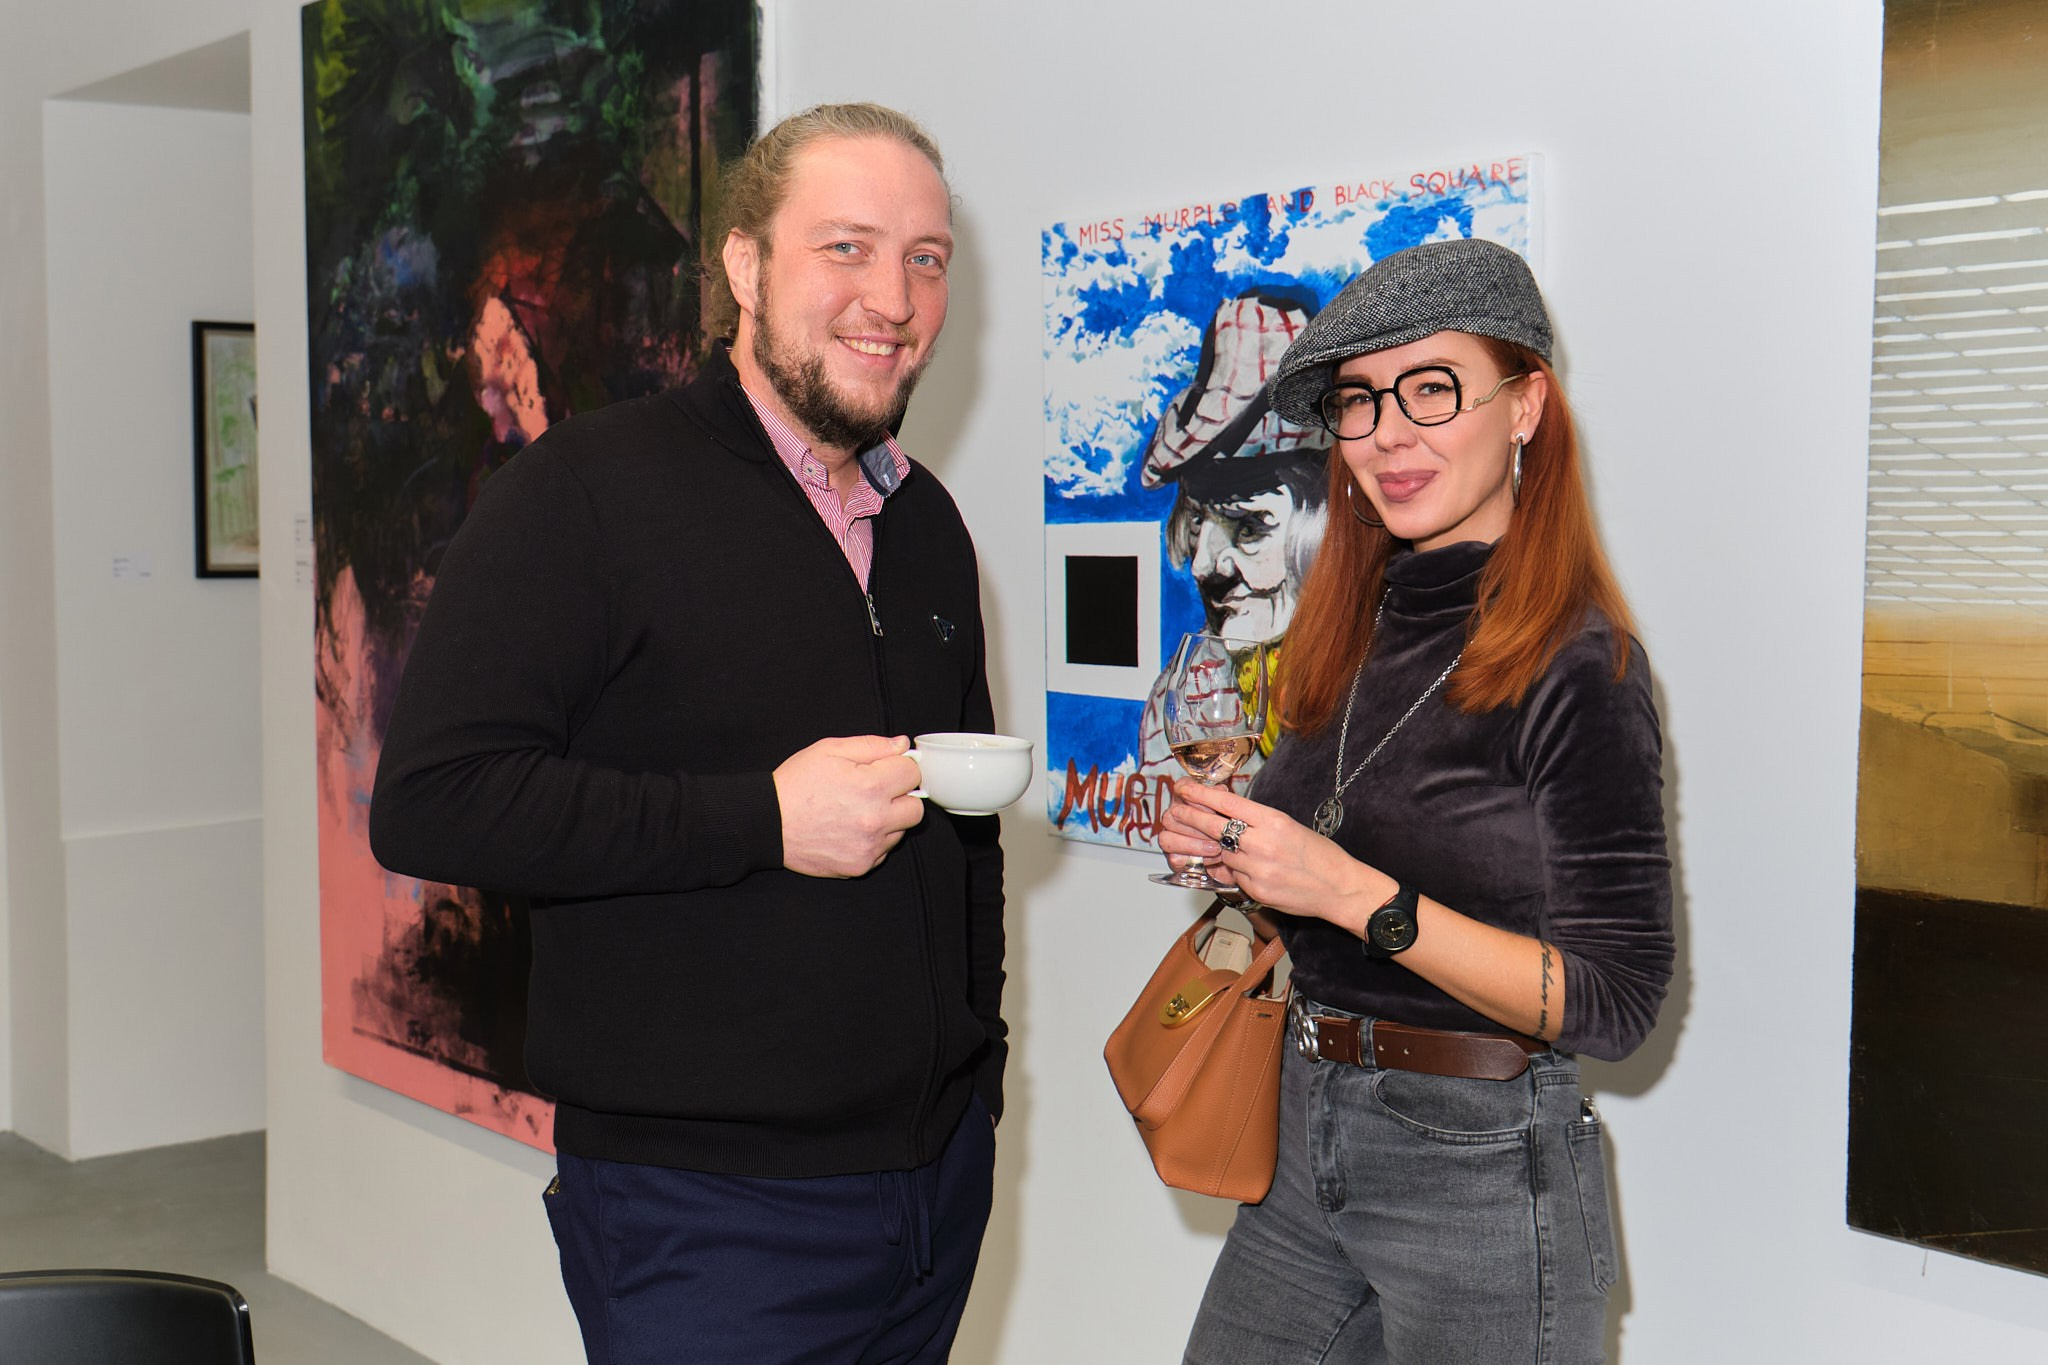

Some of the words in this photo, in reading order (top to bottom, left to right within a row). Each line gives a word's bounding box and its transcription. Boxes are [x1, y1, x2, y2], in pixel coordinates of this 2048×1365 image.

[1079, 218, 1124, 247] MISS
[1267, 189, 1315, 216] AND
[1335, 179, 1399, 206] BLACK
[1408, 157, 1524, 200] SQUARE
